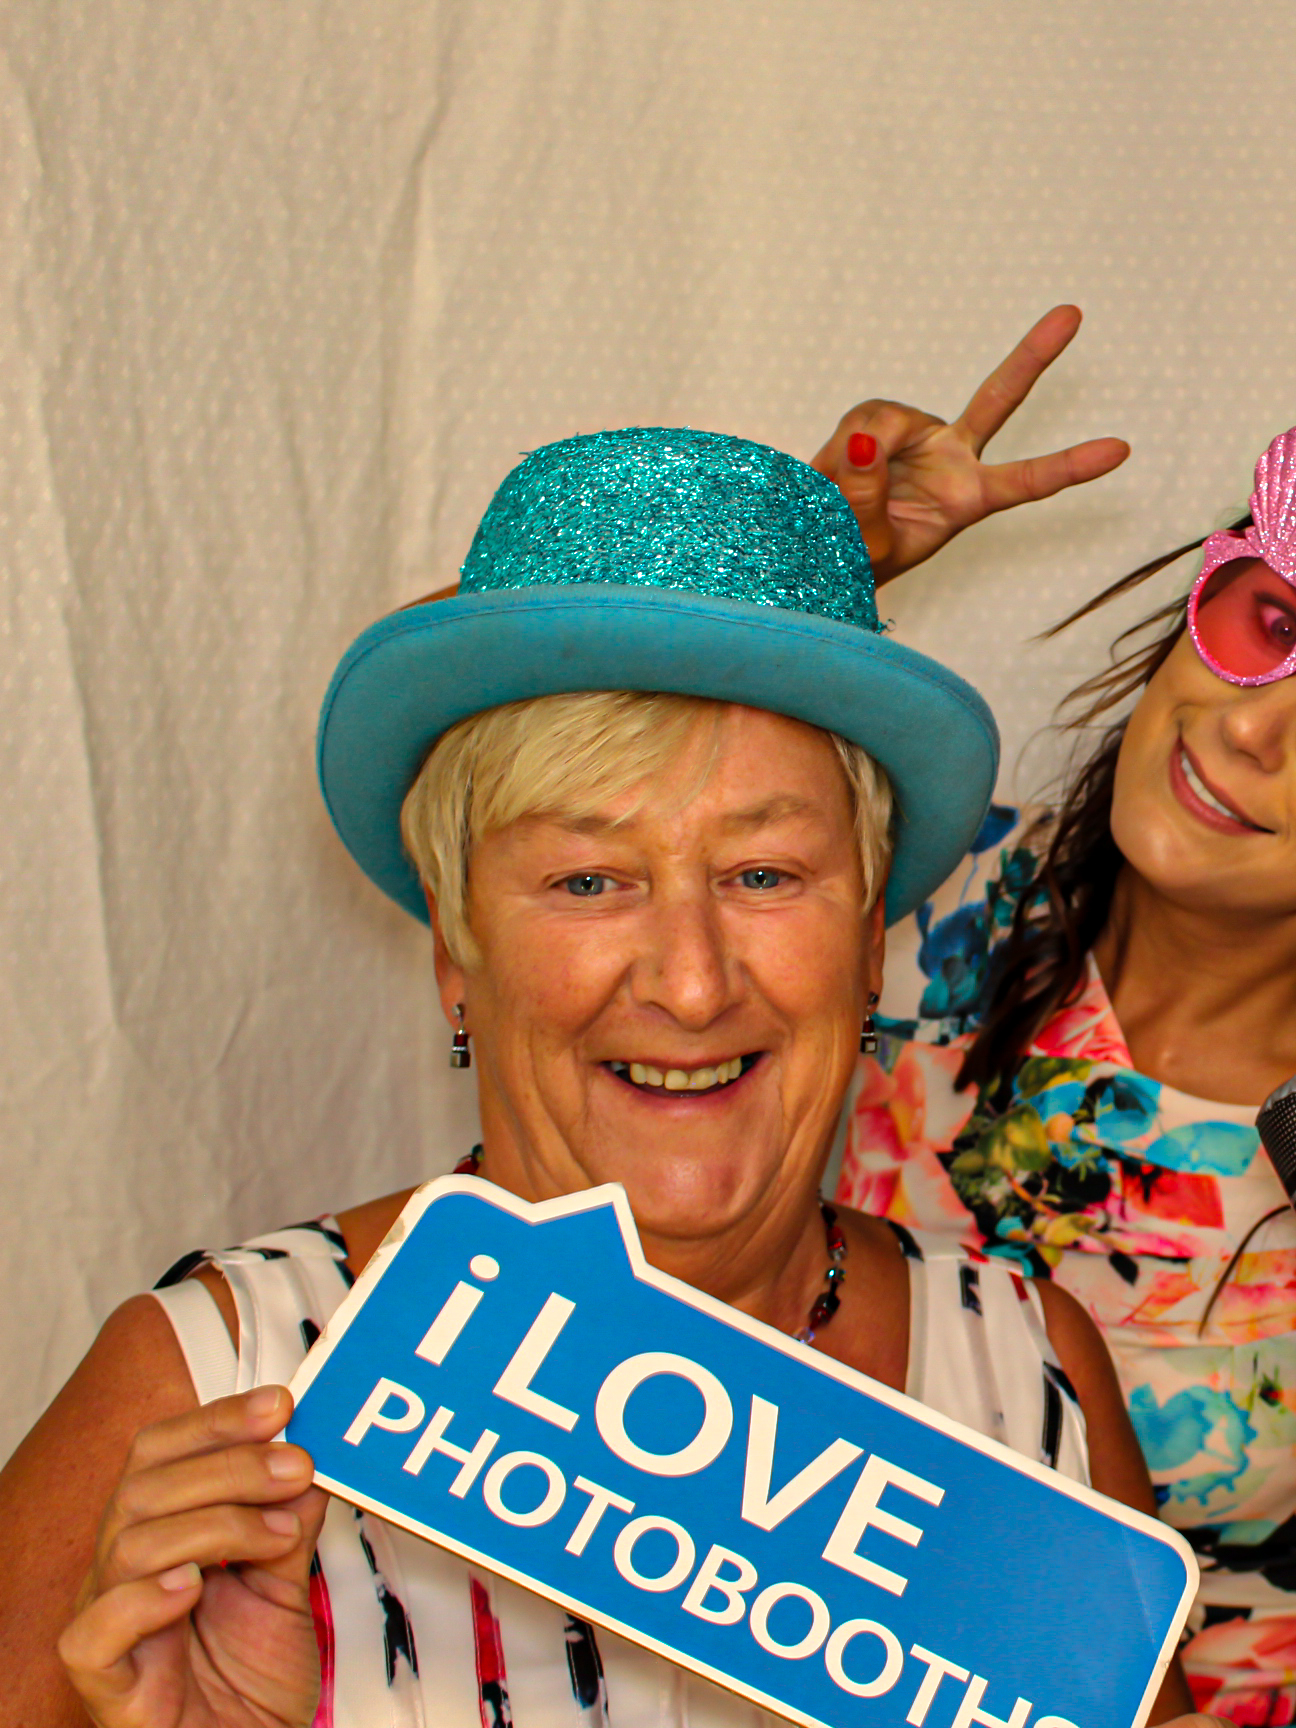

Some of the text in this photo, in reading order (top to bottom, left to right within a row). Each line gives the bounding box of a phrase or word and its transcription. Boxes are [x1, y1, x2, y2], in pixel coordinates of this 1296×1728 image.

[342, 1376, 1081, 1728] PHOTOBOOTH
[413, 1253, 946, 1598] i LOVE
